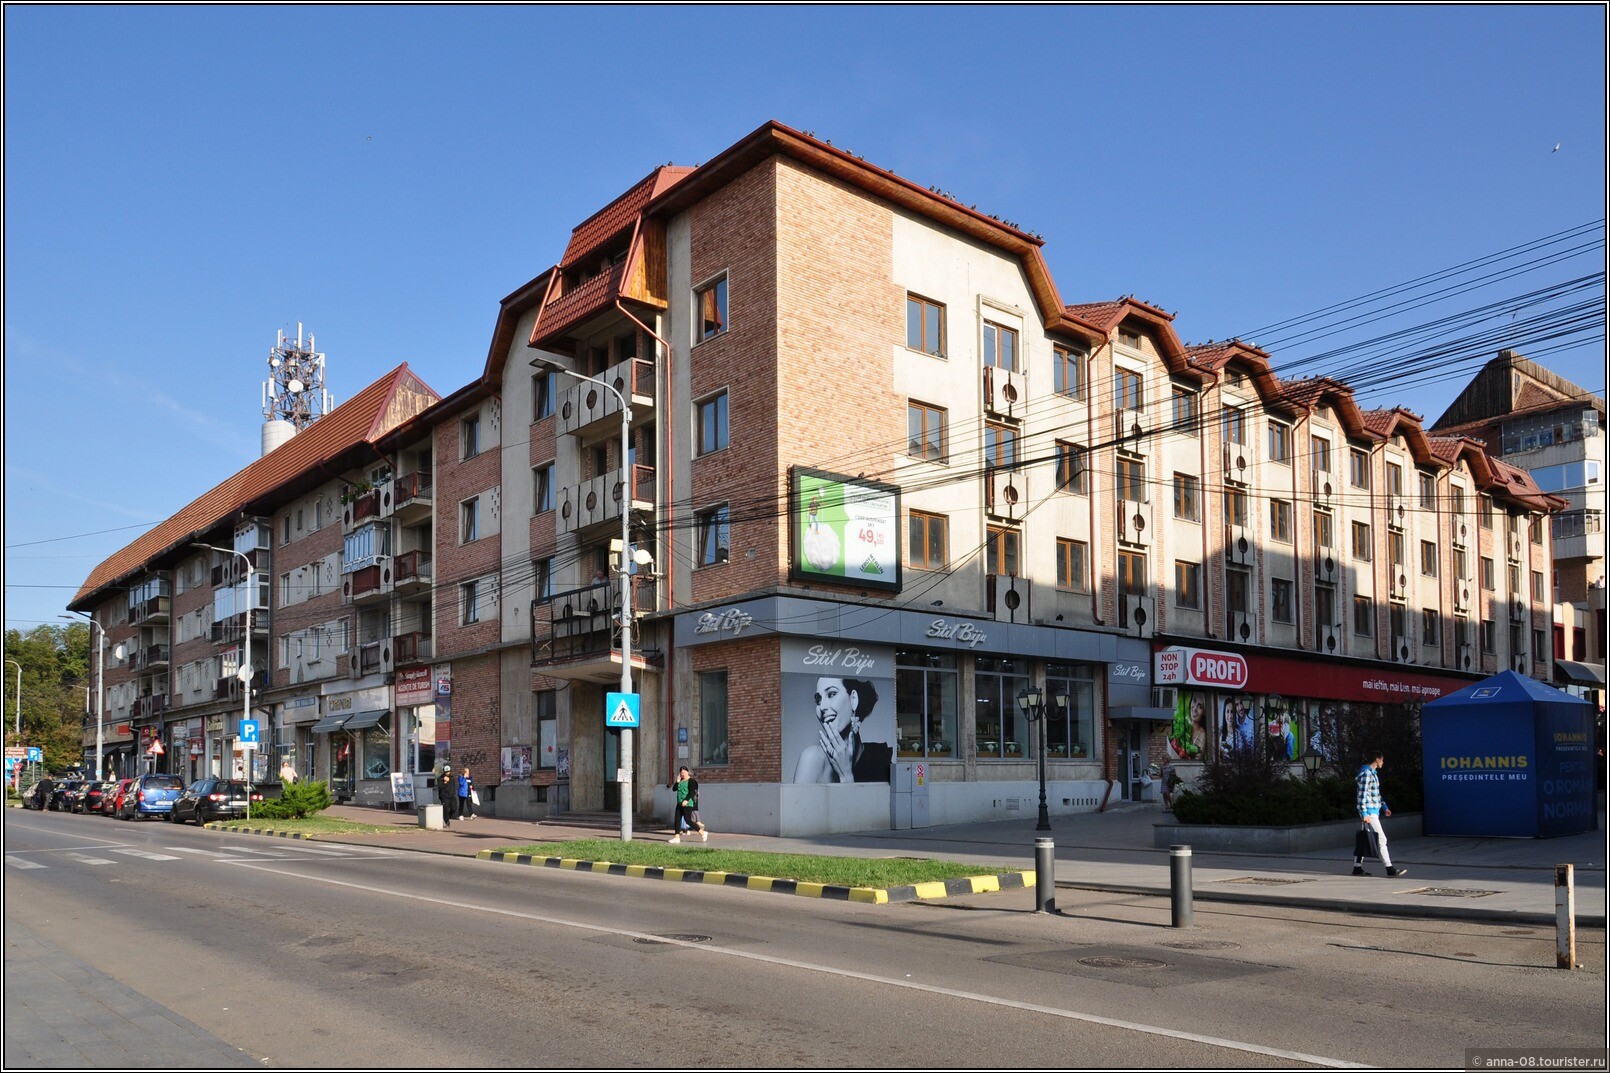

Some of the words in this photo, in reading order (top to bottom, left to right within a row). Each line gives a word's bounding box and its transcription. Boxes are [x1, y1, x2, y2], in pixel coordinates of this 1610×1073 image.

[694, 613, 725, 635] Stil
[722, 608, 752, 635] Biju
[928, 619, 960, 639] Stil
[958, 622, 988, 648] Biju
[803, 645, 842, 666] Stil
[841, 647, 875, 675] Biju
[1161, 653, 1178, 662] NON
[1113, 664, 1130, 677] Stil
[1131, 665, 1146, 682] Biju
[1160, 663, 1179, 671] STOP
[1196, 657, 1241, 682] PROFI
[1162, 673, 1177, 682] 24h
[1362, 678, 1374, 689] mai
[1390, 681, 1400, 692] mai
[1411, 684, 1421, 694] mai
[1421, 686, 1441, 696] aproape
[245, 724, 256, 738] P
[1553, 732, 1587, 743] IOHANNIS
[1441, 755, 1528, 768] IOHANNIS
[1441, 774, 1505, 782] PREȘEDINTELE
